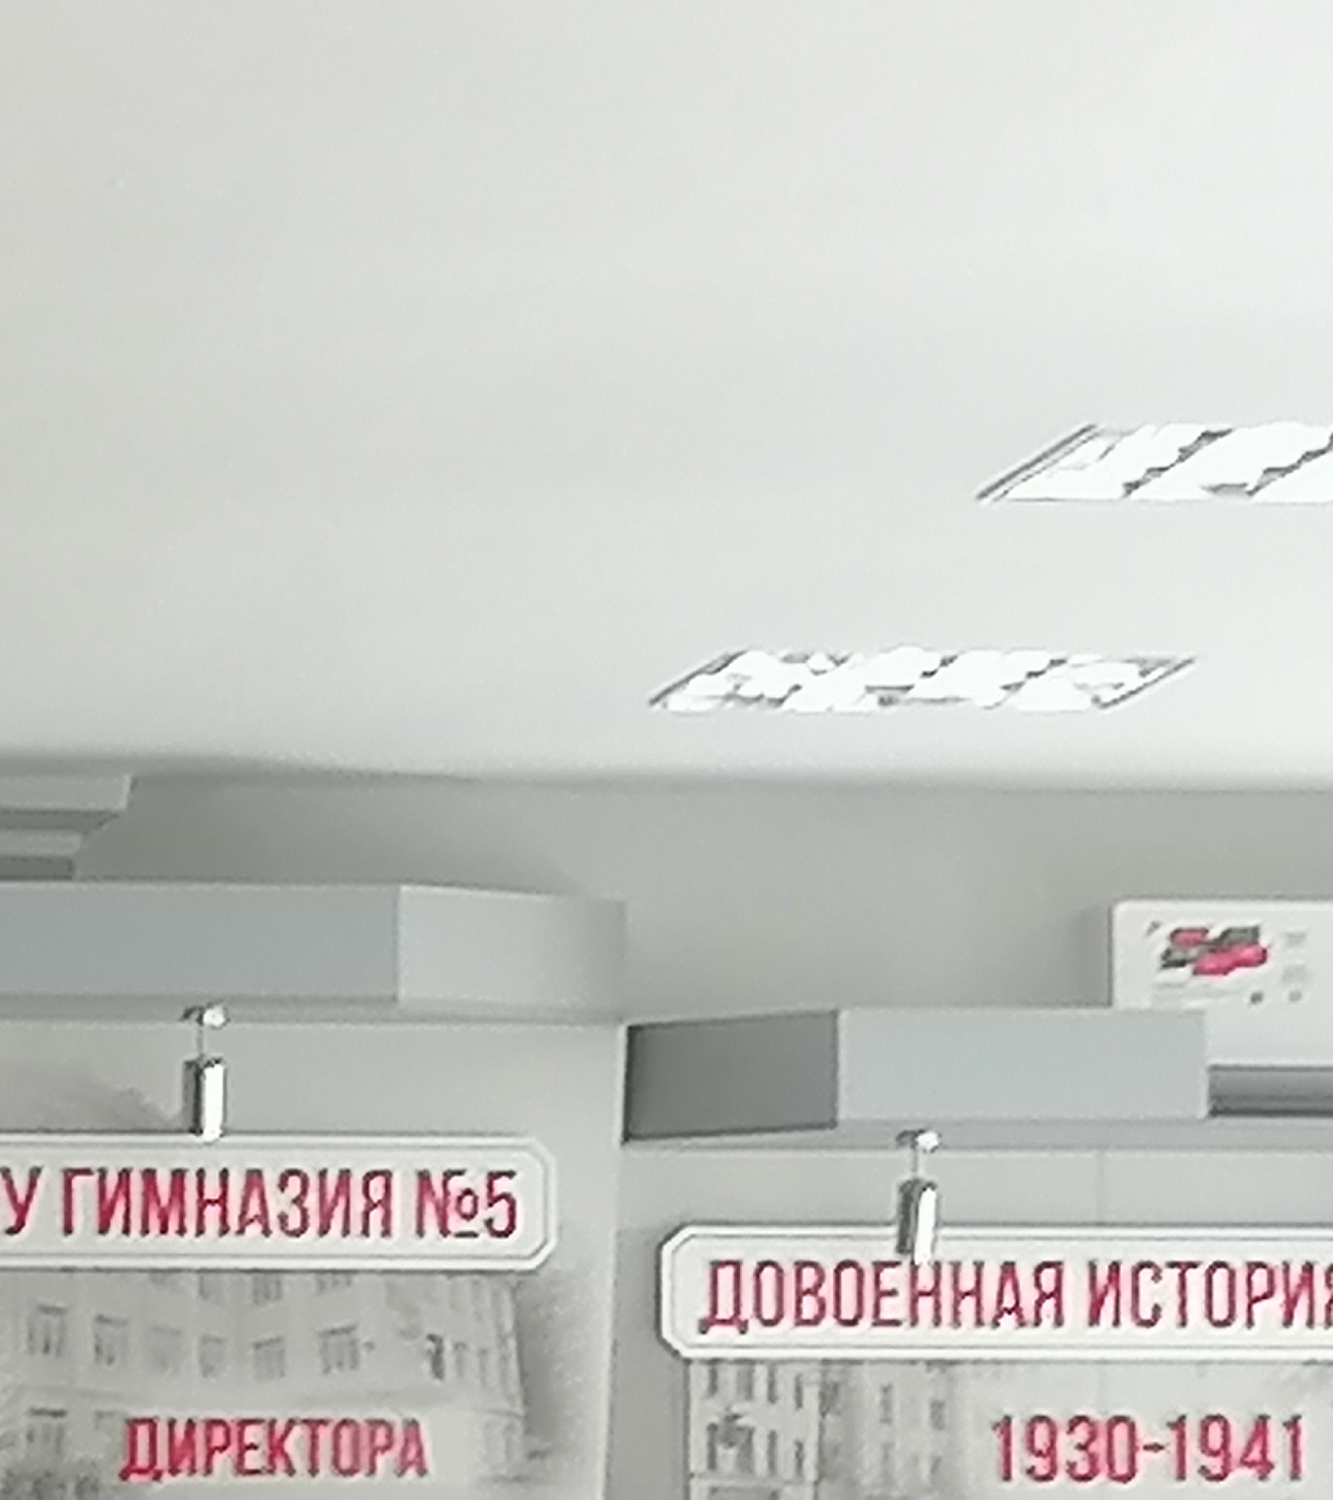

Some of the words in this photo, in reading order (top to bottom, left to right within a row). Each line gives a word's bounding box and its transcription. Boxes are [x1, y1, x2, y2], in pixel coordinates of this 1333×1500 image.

[62, 1168, 393, 1237] ГИМНАЗИЯ
[415, 1169, 518, 1238] №5
[697, 1260, 1065, 1334] ДОВОЕННАЯ
[119, 1416, 428, 1483] ДИРЕКТОРА
[994, 1414, 1306, 1484] 1930-1941
